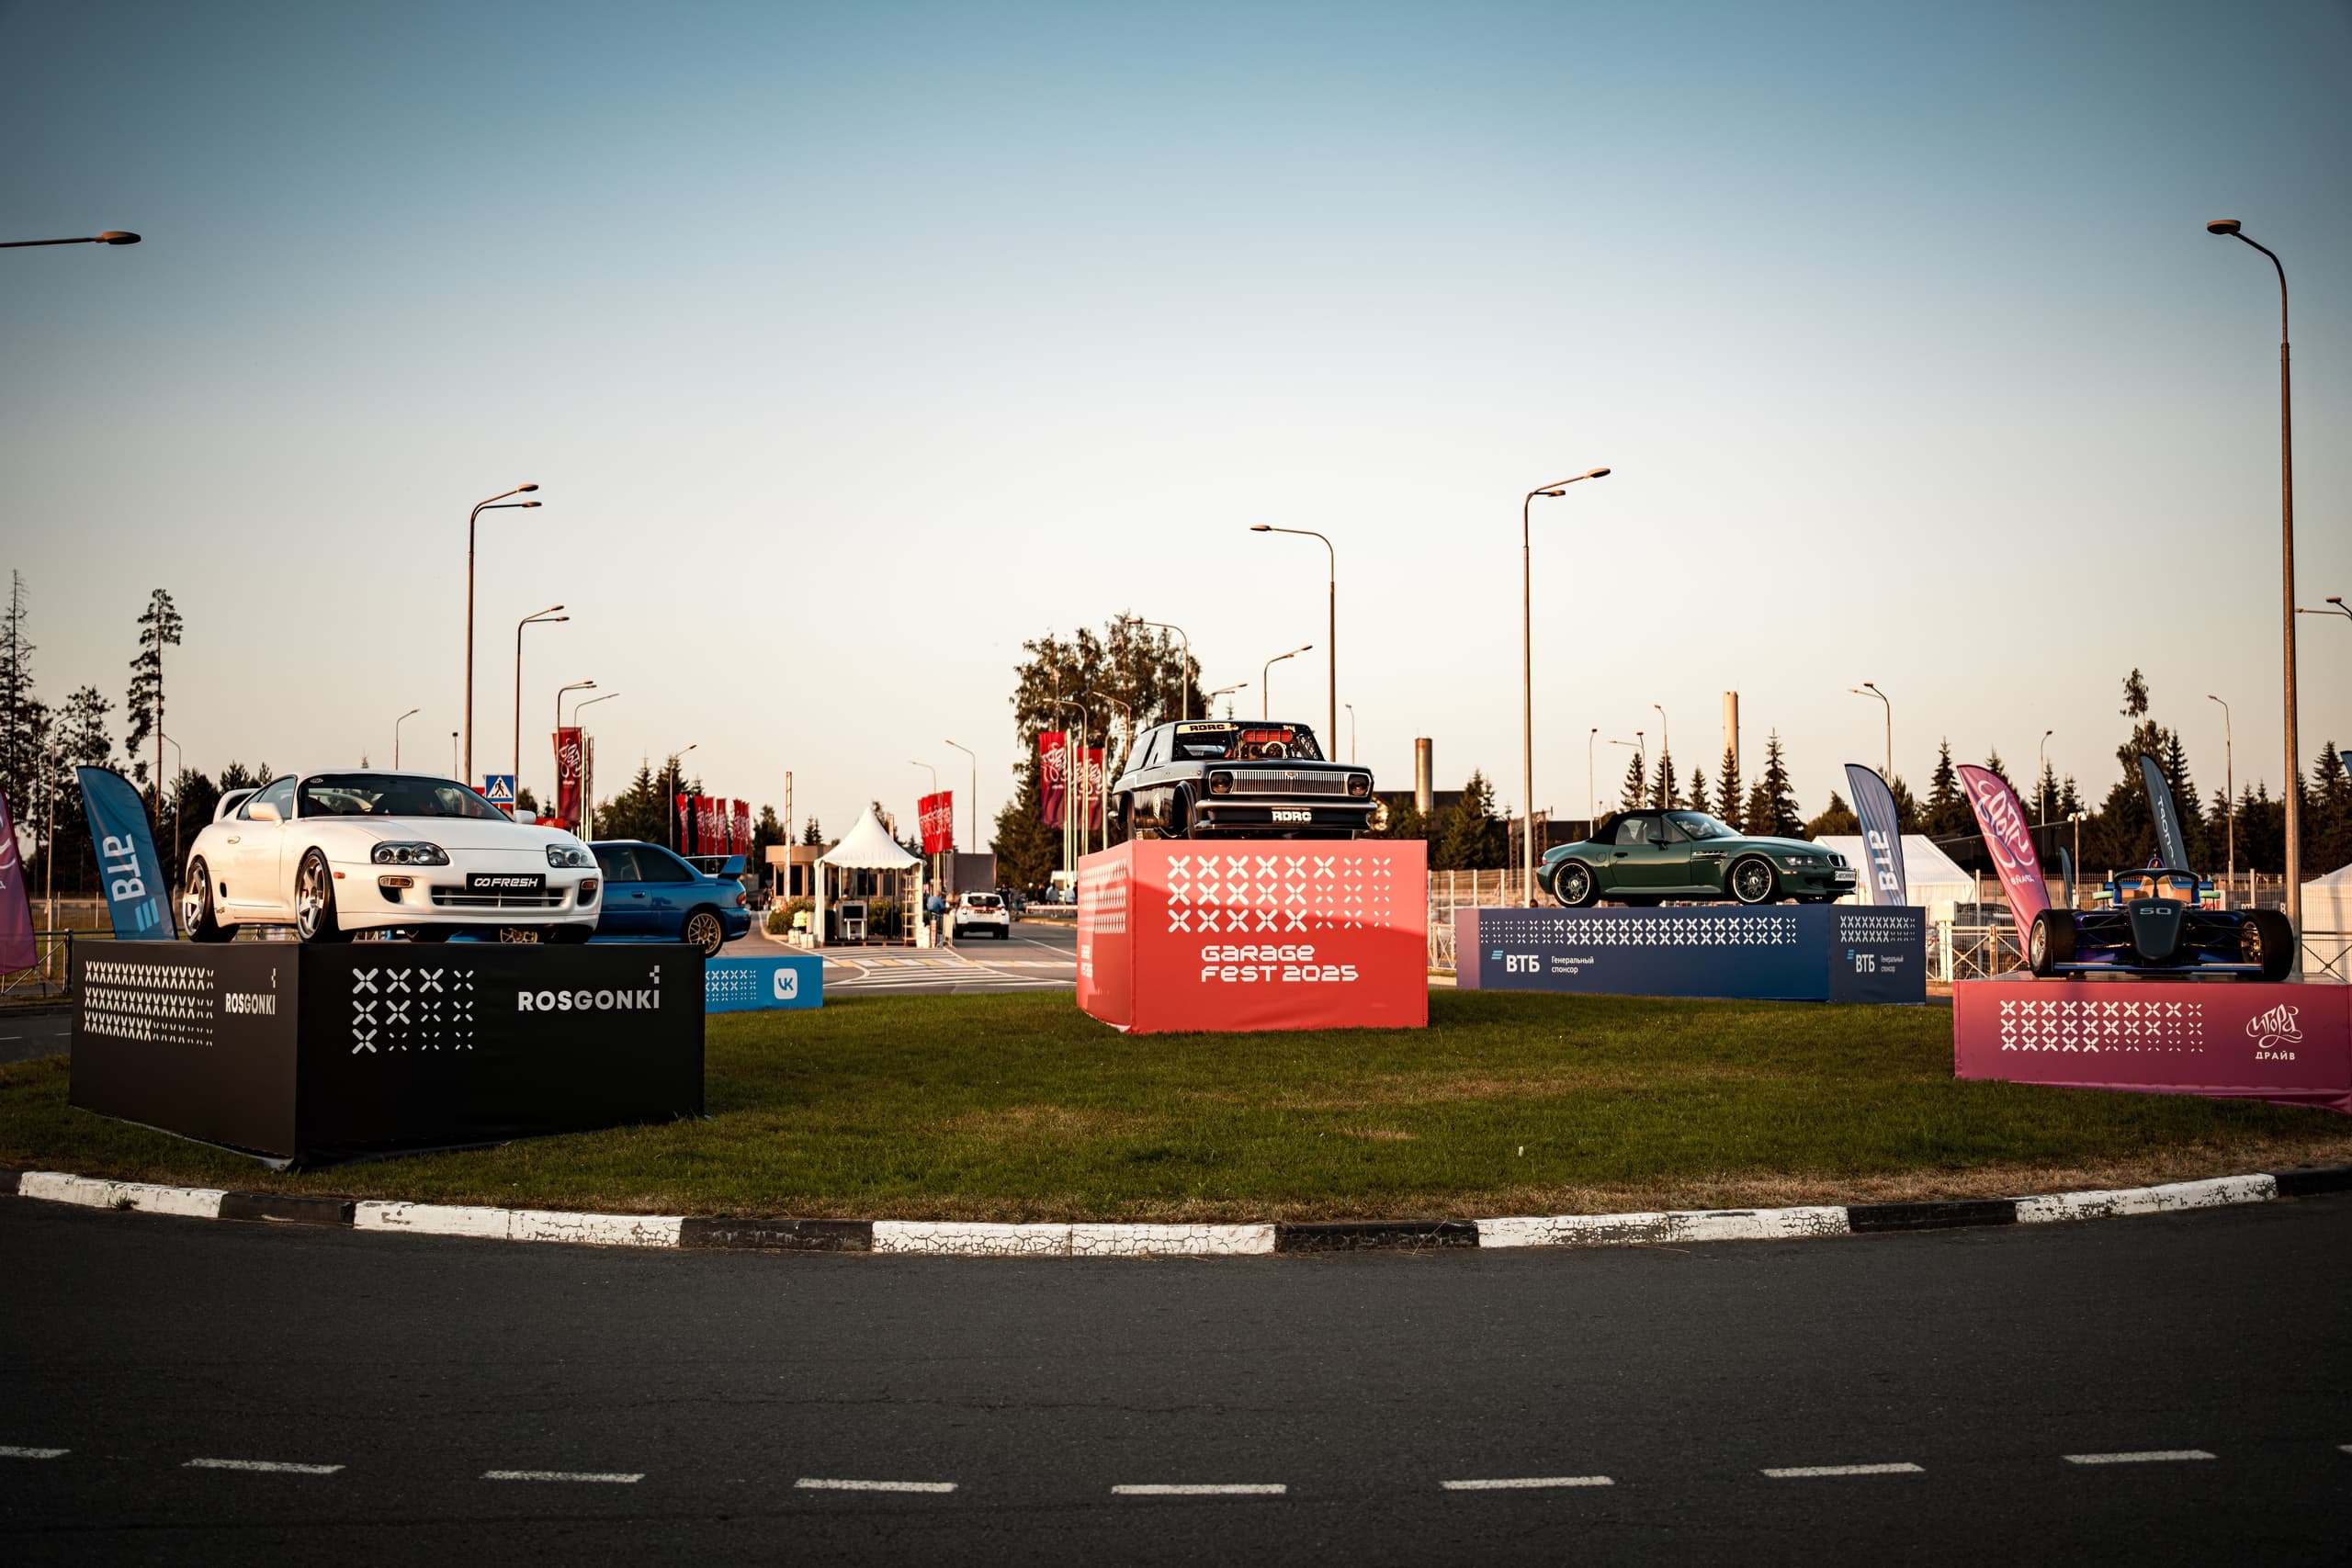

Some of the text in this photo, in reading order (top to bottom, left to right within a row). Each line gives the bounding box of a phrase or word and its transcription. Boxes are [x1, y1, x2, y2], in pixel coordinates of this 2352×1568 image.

[1272, 810, 1312, 821] RDRC
[1506, 954, 1541, 973] ВТБ
[1551, 955, 1594, 965] Генеральный
[1856, 953, 1875, 973] ВТБ
[1282, 964, 1360, 983] 2025
[1551, 965, 1578, 975] спонсор
[225, 992, 276, 1015] ROSGONKI
[517, 989, 660, 1011] ROSGONKI
[2255, 1050, 2296, 1061] ДРАЙВ
